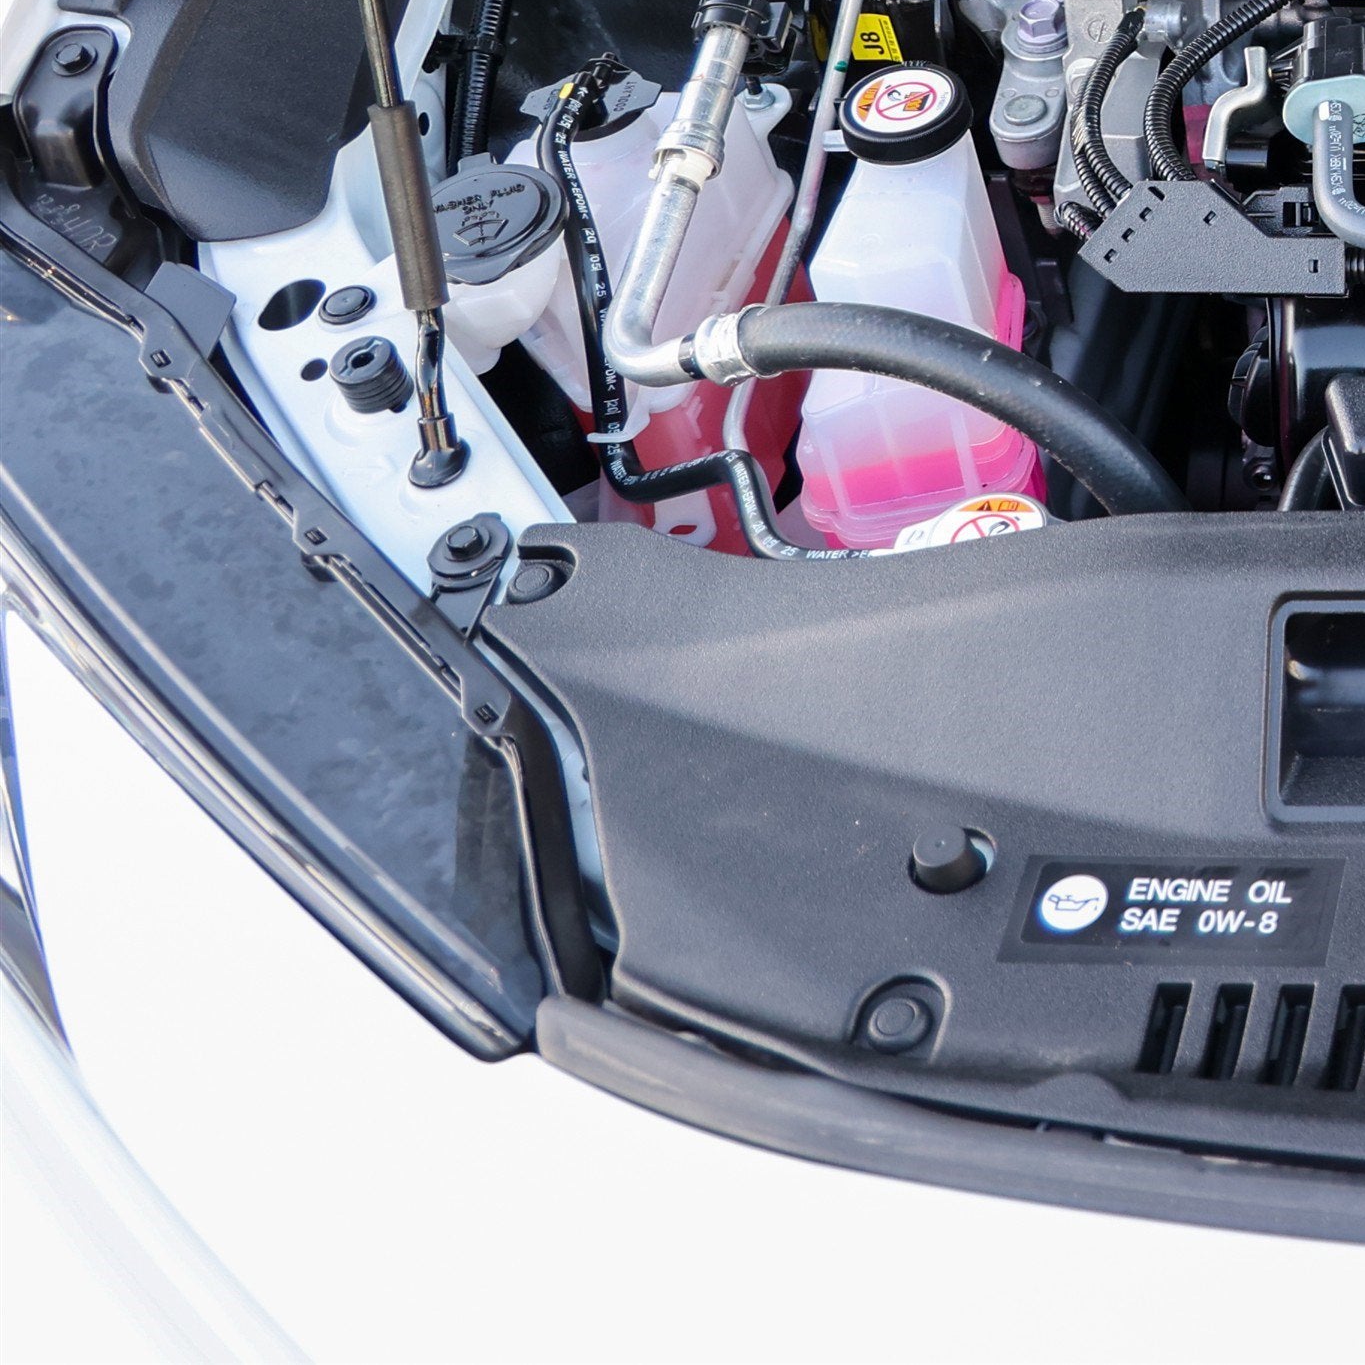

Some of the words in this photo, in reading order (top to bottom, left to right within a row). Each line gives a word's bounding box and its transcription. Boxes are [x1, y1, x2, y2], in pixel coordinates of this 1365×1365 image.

[860, 31, 884, 55] J8
[557, 149, 576, 179] WATER
[806, 550, 847, 558] WATER
[1128, 878, 1232, 903] ENGINE
[1248, 880, 1292, 904] OIL
[1119, 908, 1181, 932] SAE
[1198, 910, 1279, 934] 0W-8
